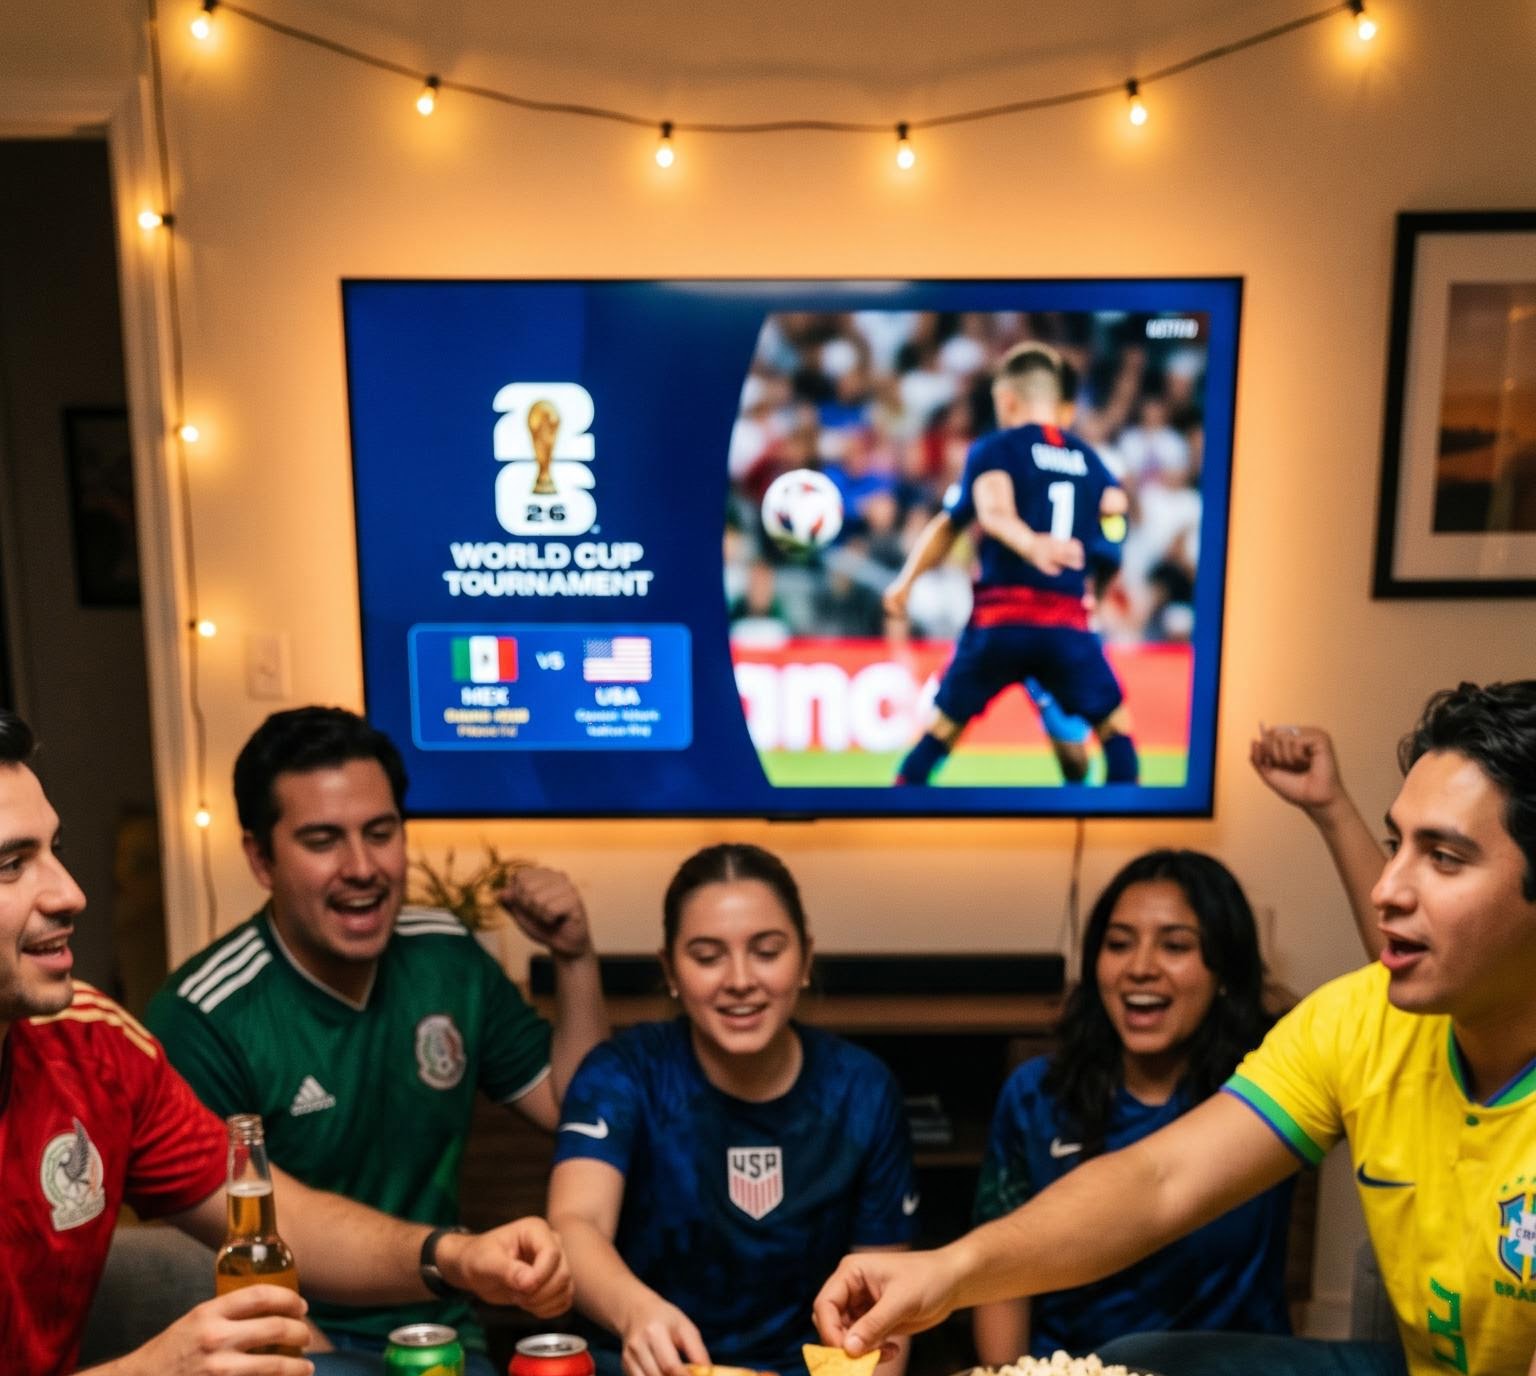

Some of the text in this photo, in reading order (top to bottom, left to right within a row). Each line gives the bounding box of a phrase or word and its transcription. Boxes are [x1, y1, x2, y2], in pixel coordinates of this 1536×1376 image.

[527, 505, 566, 522] 26
[450, 541, 645, 570] WORLD CUP
[442, 570, 654, 597] TOURNAMENT
